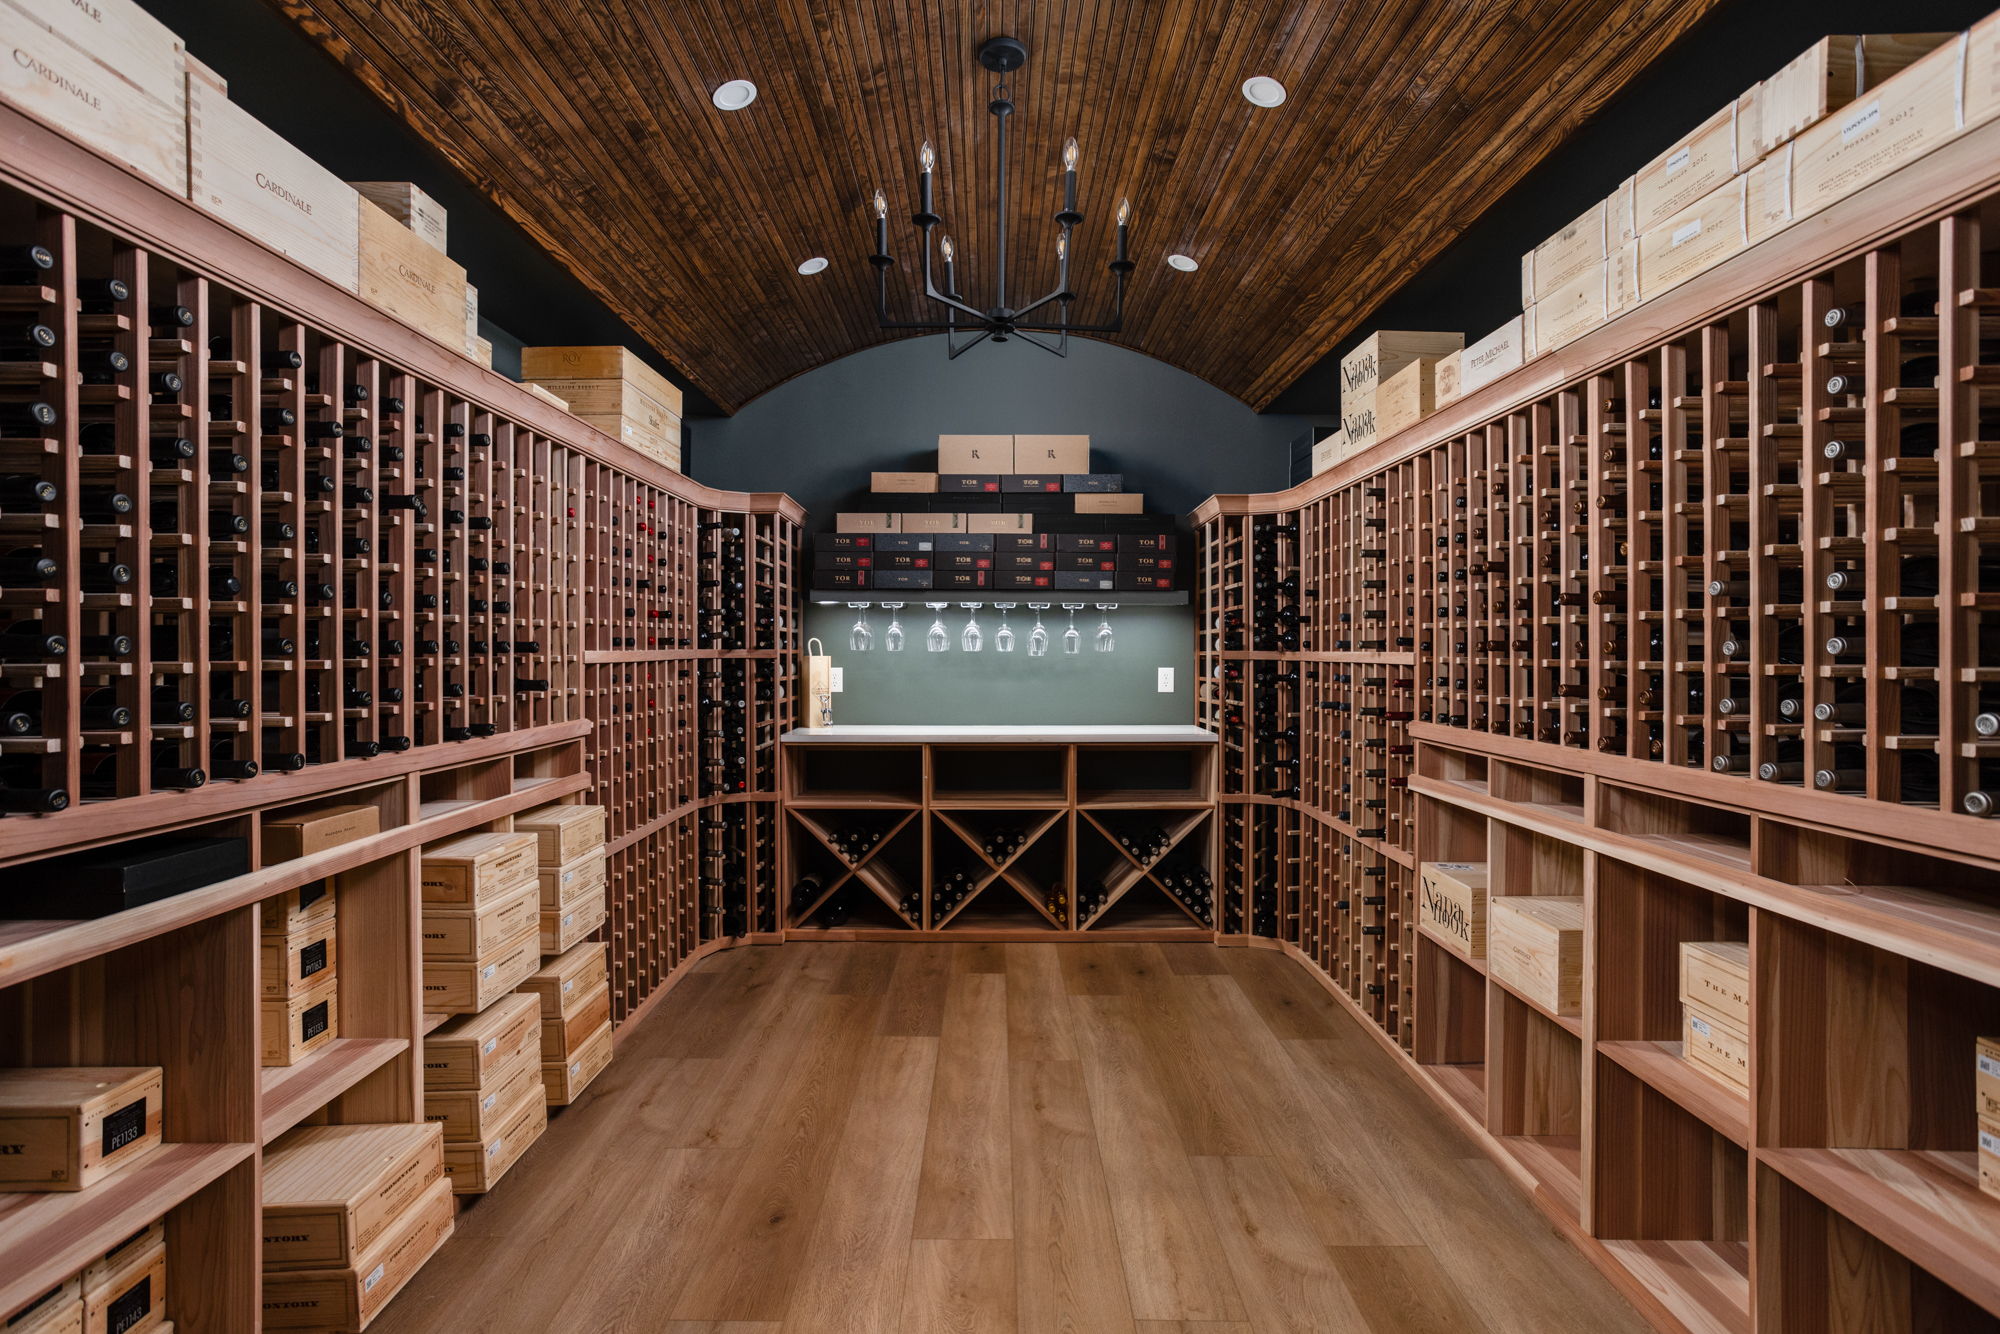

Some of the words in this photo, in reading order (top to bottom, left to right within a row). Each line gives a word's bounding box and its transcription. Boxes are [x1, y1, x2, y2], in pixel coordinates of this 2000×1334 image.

[12, 48, 102, 111] CARDINALE
[255, 172, 312, 216] CARDINALE
[398, 264, 436, 294] CARDINALE
[562, 352, 582, 366] ROY
[1470, 354, 1485, 368] PETER
[1485, 340, 1510, 360] MICHAEL
[972, 450, 980, 459] R
[1048, 450, 1056, 459] R
[1704, 980, 1727, 996] THE
[1708, 1041, 1730, 1058] THE
[112, 1126, 138, 1150] PE1133
[380, 1160, 420, 1197] PROMONTORY
